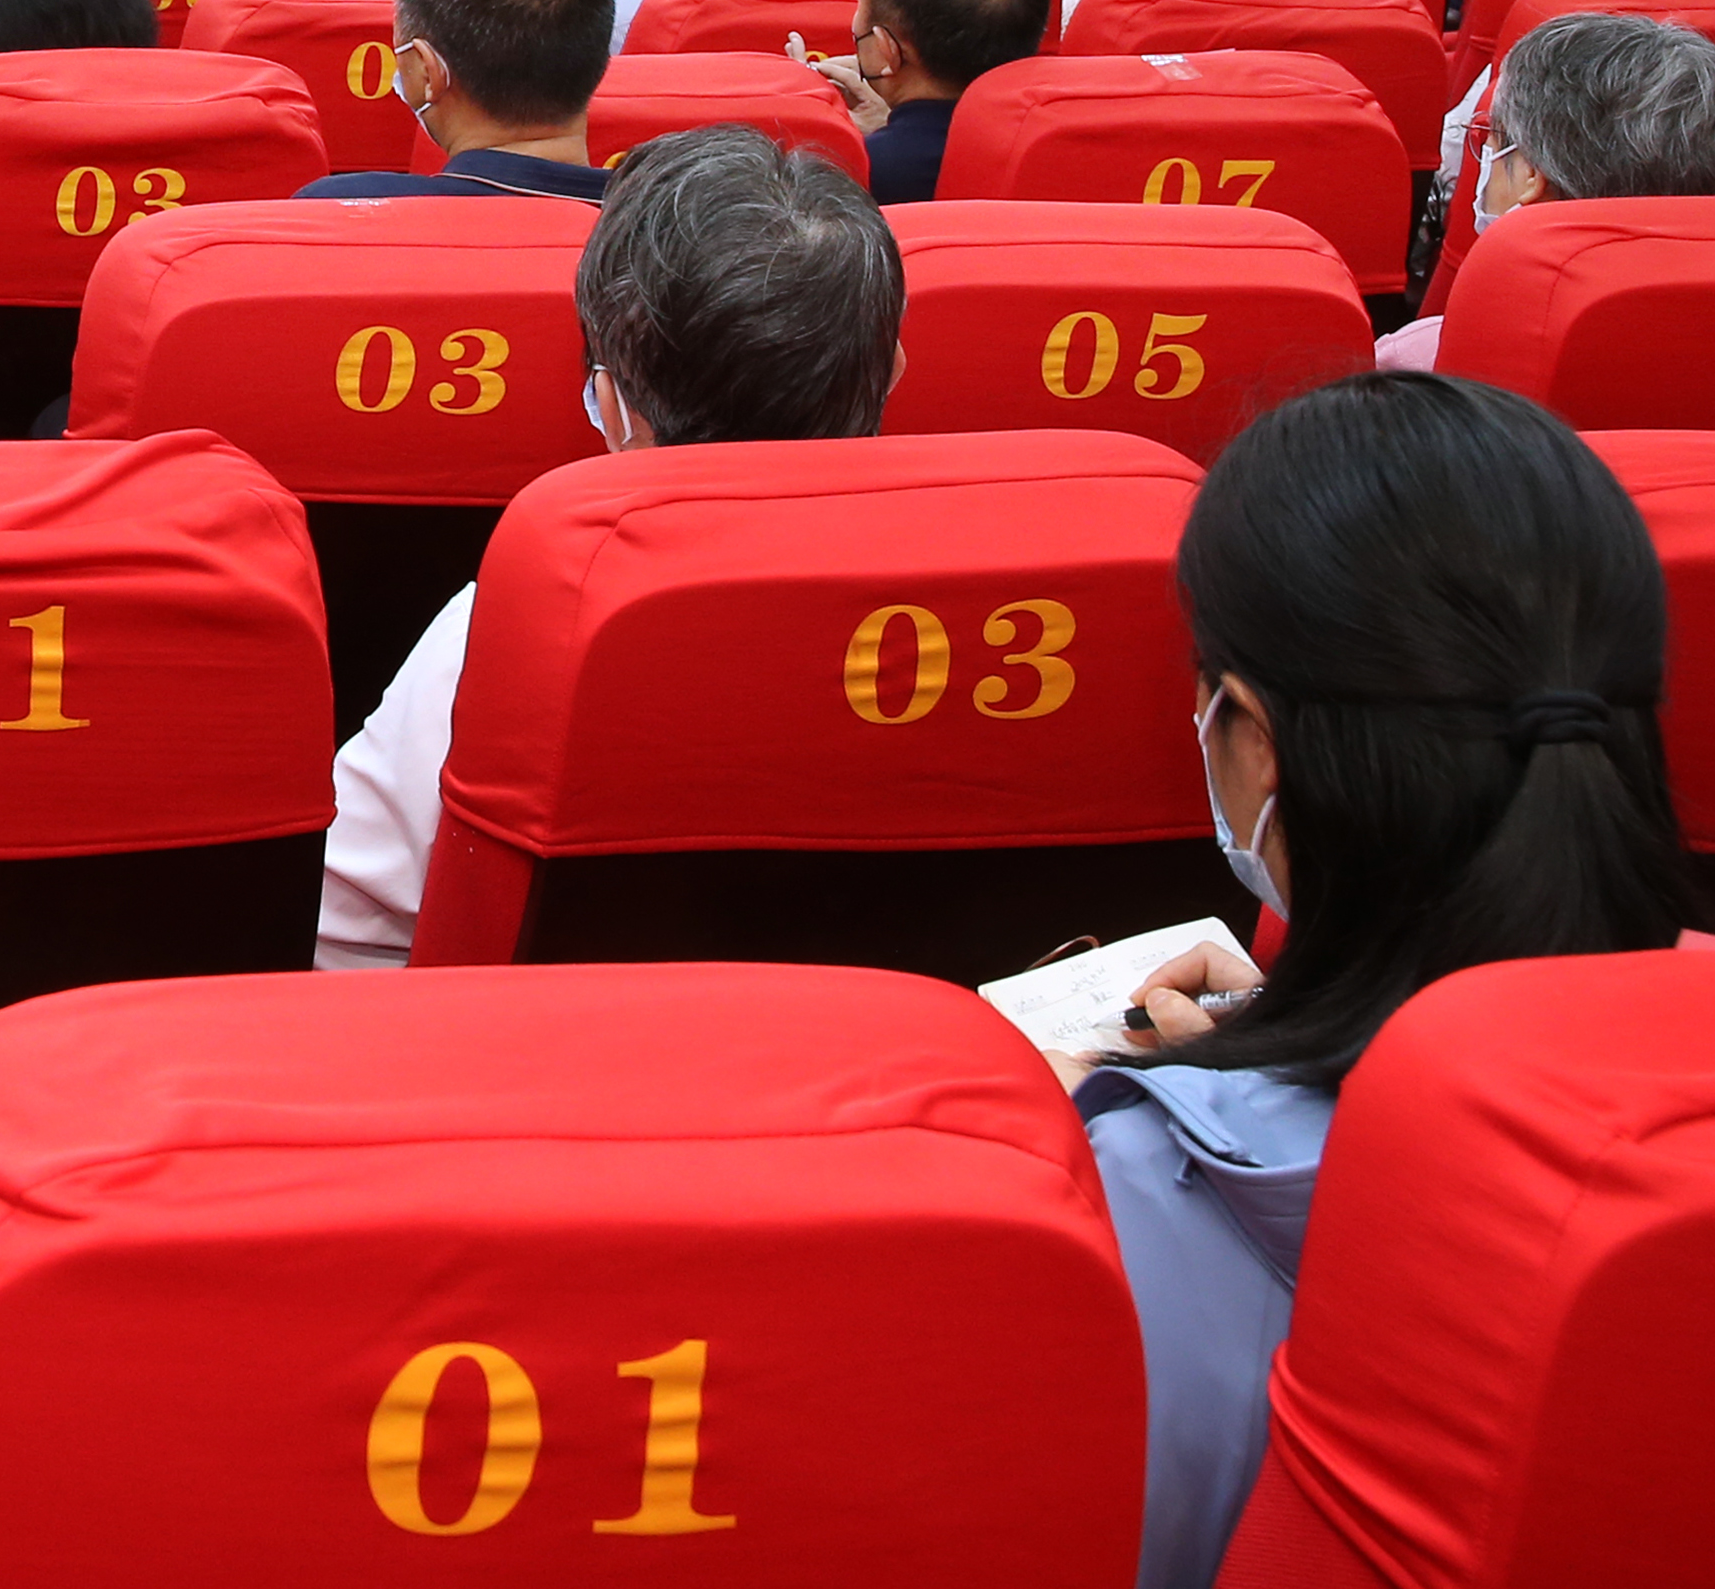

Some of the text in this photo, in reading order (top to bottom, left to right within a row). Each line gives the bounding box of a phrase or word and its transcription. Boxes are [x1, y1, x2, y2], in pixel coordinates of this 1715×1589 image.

[56, 166, 188, 237] 03
[337, 327, 511, 416] 03
[1043, 312, 1210, 400] 05
[846, 600, 1077, 725] 03
[369, 1339, 736, 1536] 01
